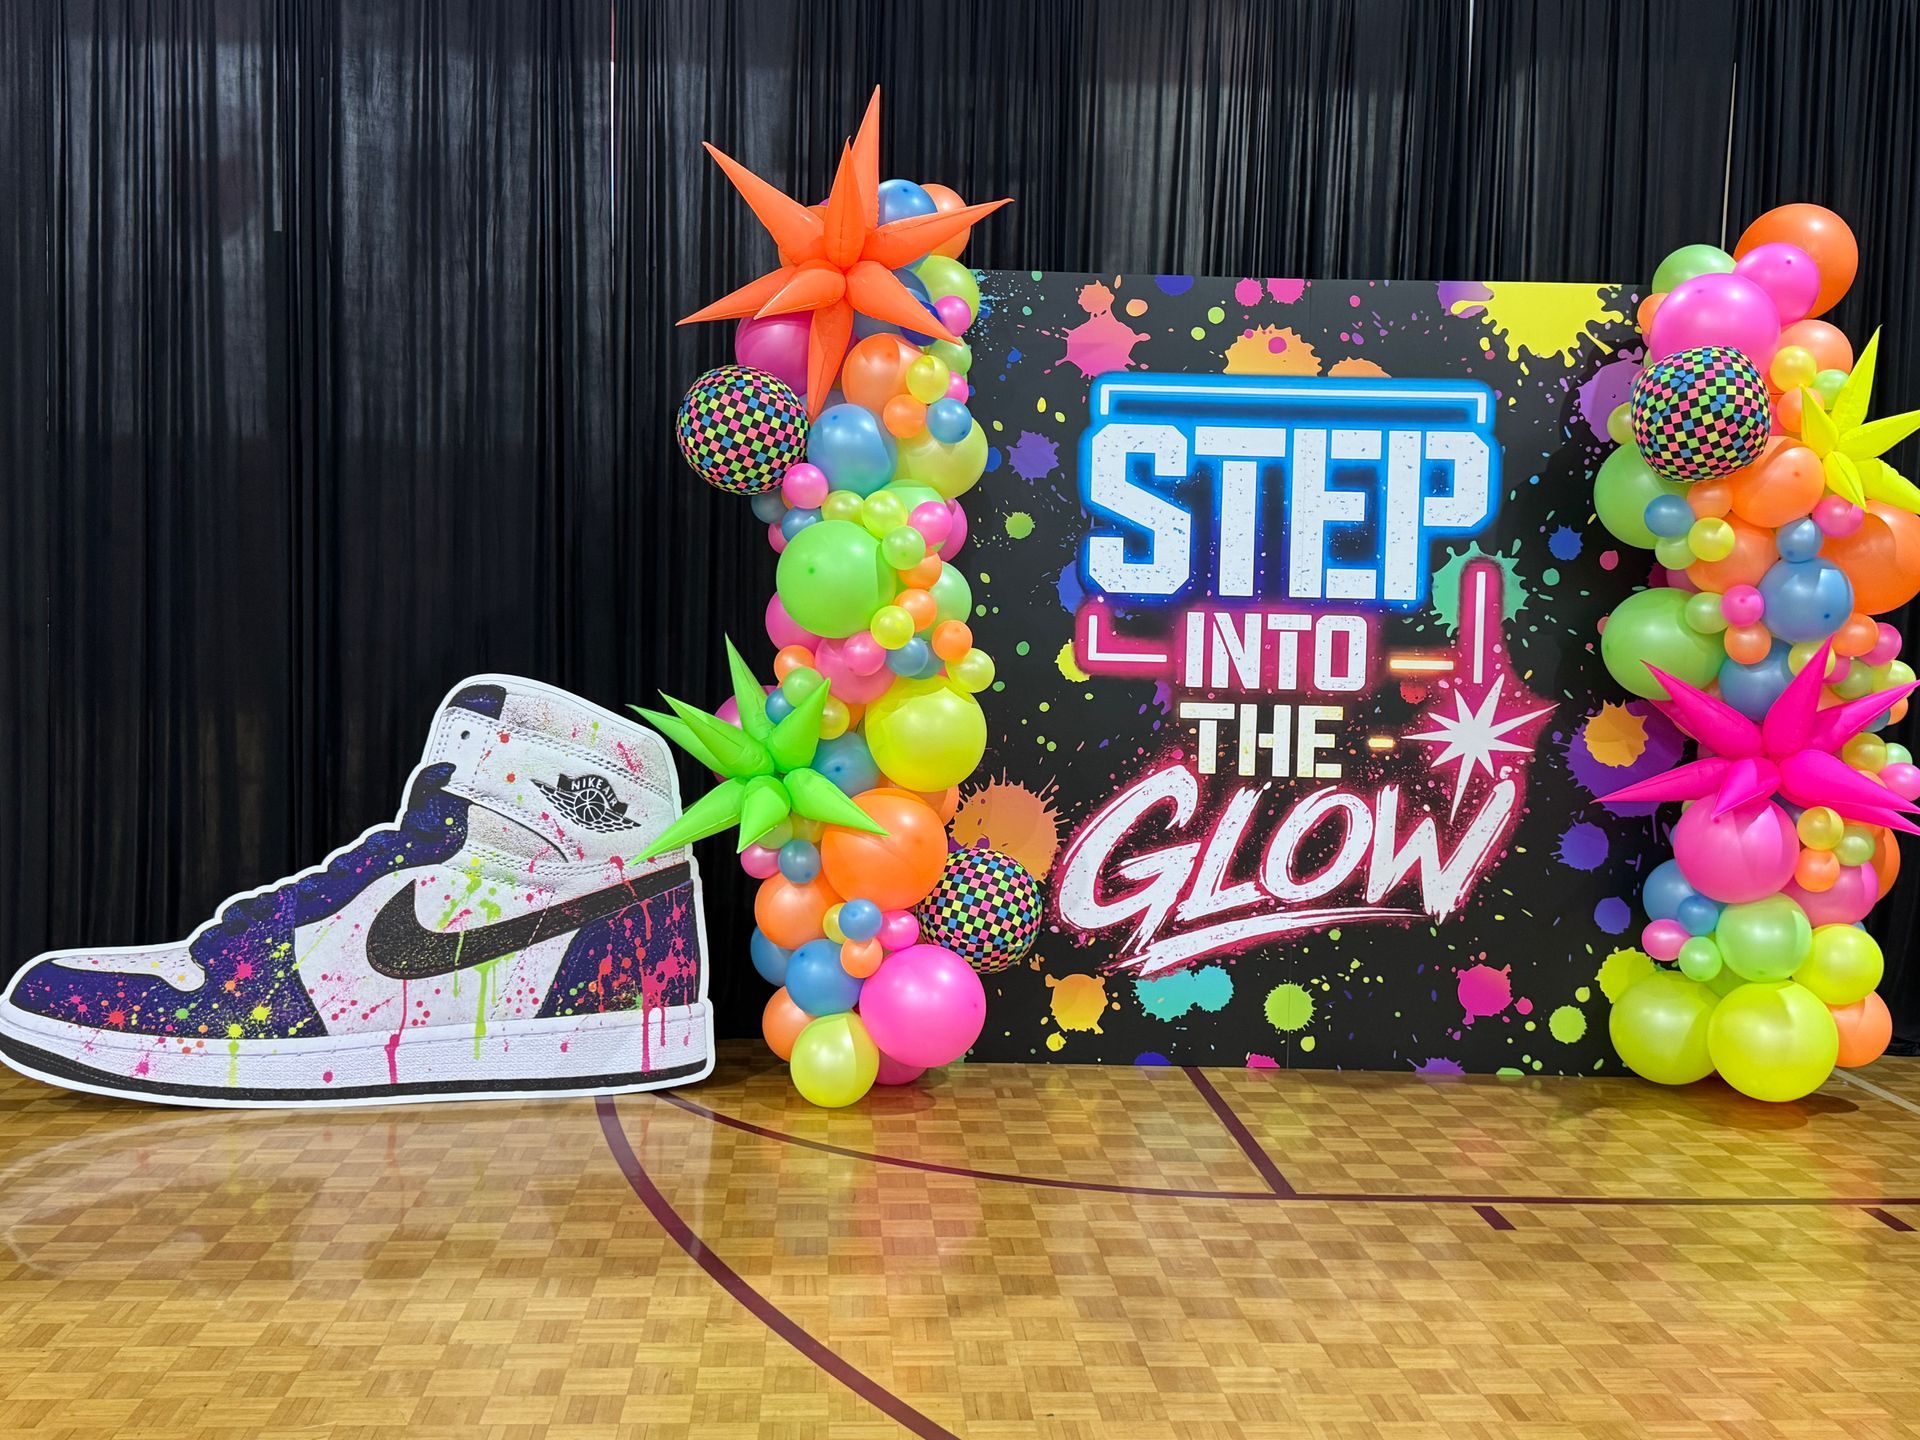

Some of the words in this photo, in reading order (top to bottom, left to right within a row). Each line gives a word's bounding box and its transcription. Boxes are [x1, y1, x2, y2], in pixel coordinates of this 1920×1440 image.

[1088, 423, 1490, 601] STEP
[1184, 611, 1368, 692] INTO
[1179, 702, 1344, 778] THE
[570, 776, 604, 791] NIKE
[601, 787, 618, 807] AIR
[1058, 764, 1516, 955] GLOW
